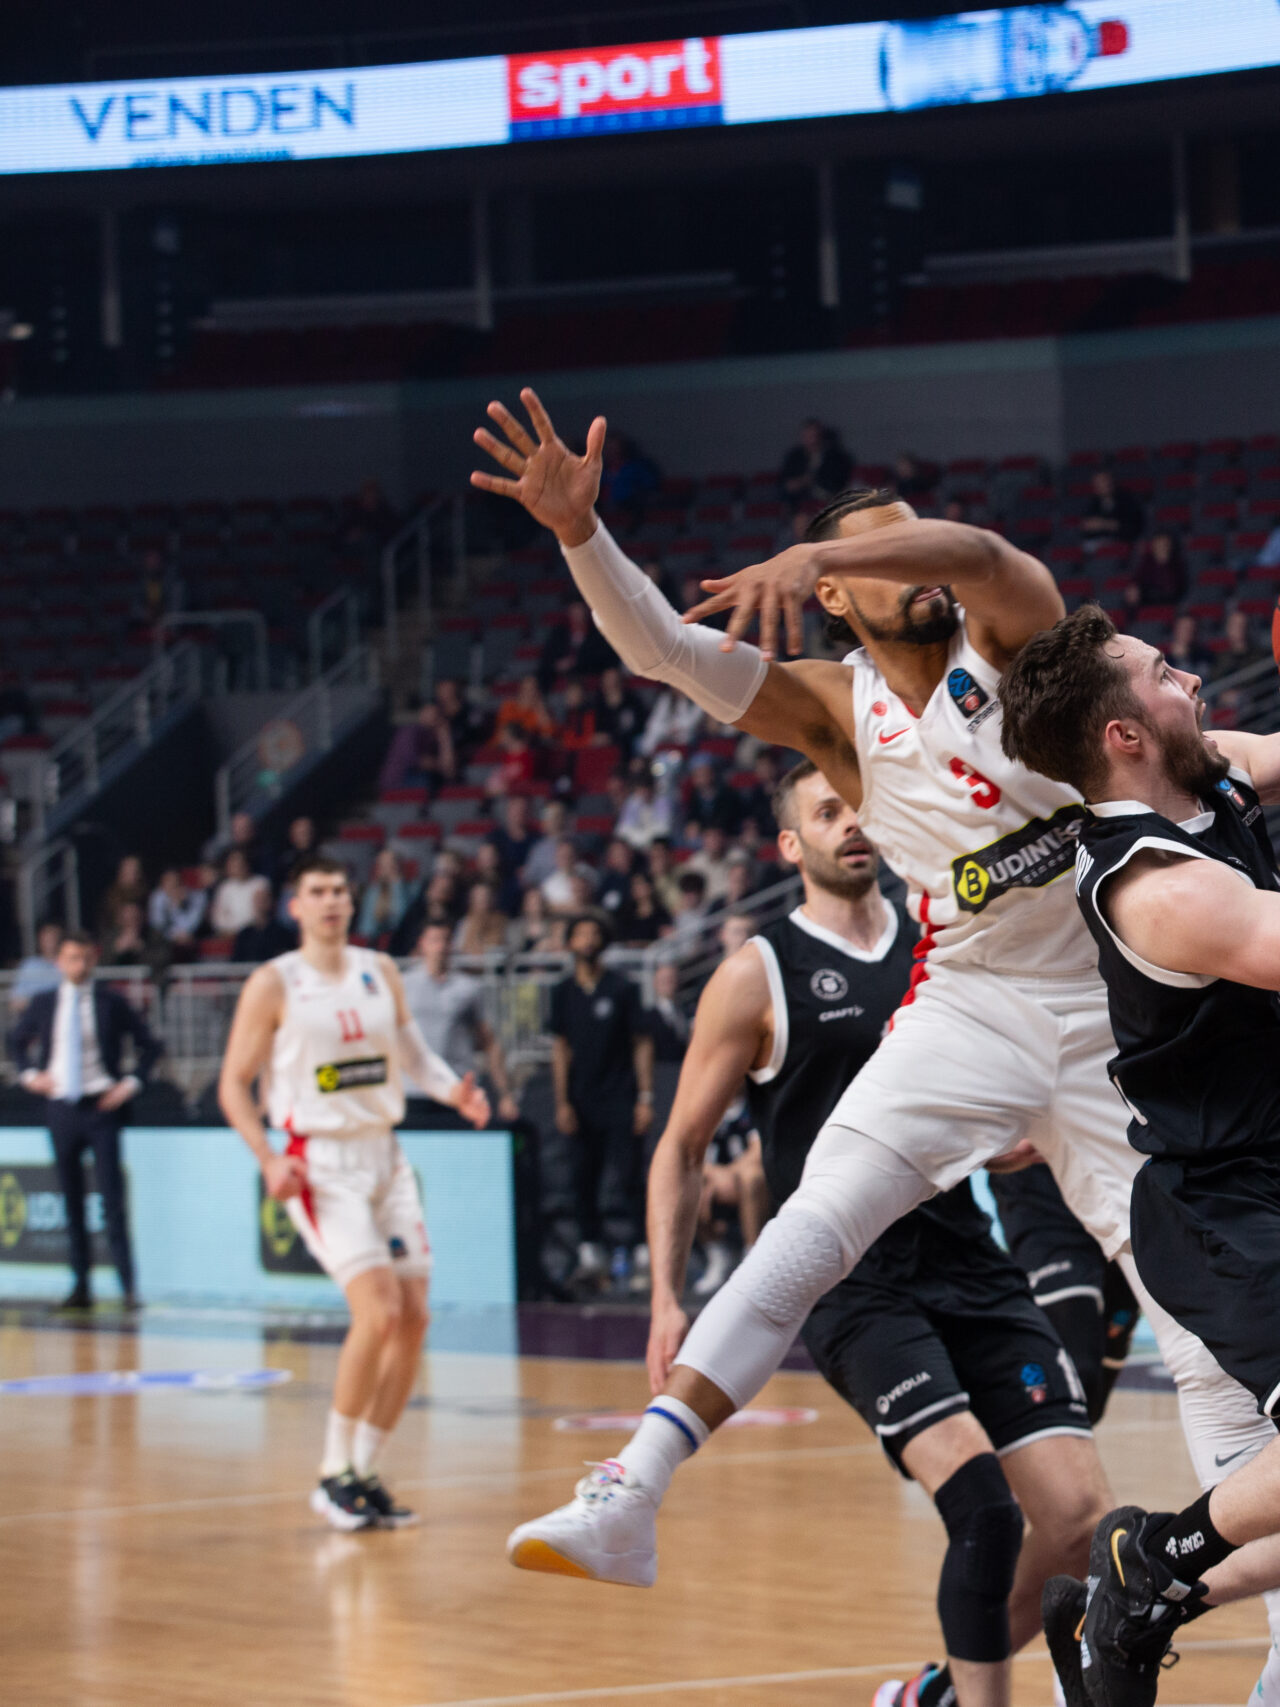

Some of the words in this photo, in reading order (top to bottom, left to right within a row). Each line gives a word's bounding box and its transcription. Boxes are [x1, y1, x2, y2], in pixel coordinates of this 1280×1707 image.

[516, 37, 713, 117] sport
[68, 82, 355, 142] VENDEN
[949, 757, 1001, 809] 3
[336, 1008, 365, 1043] 11
[886, 1371, 932, 1402] VEOLIA
